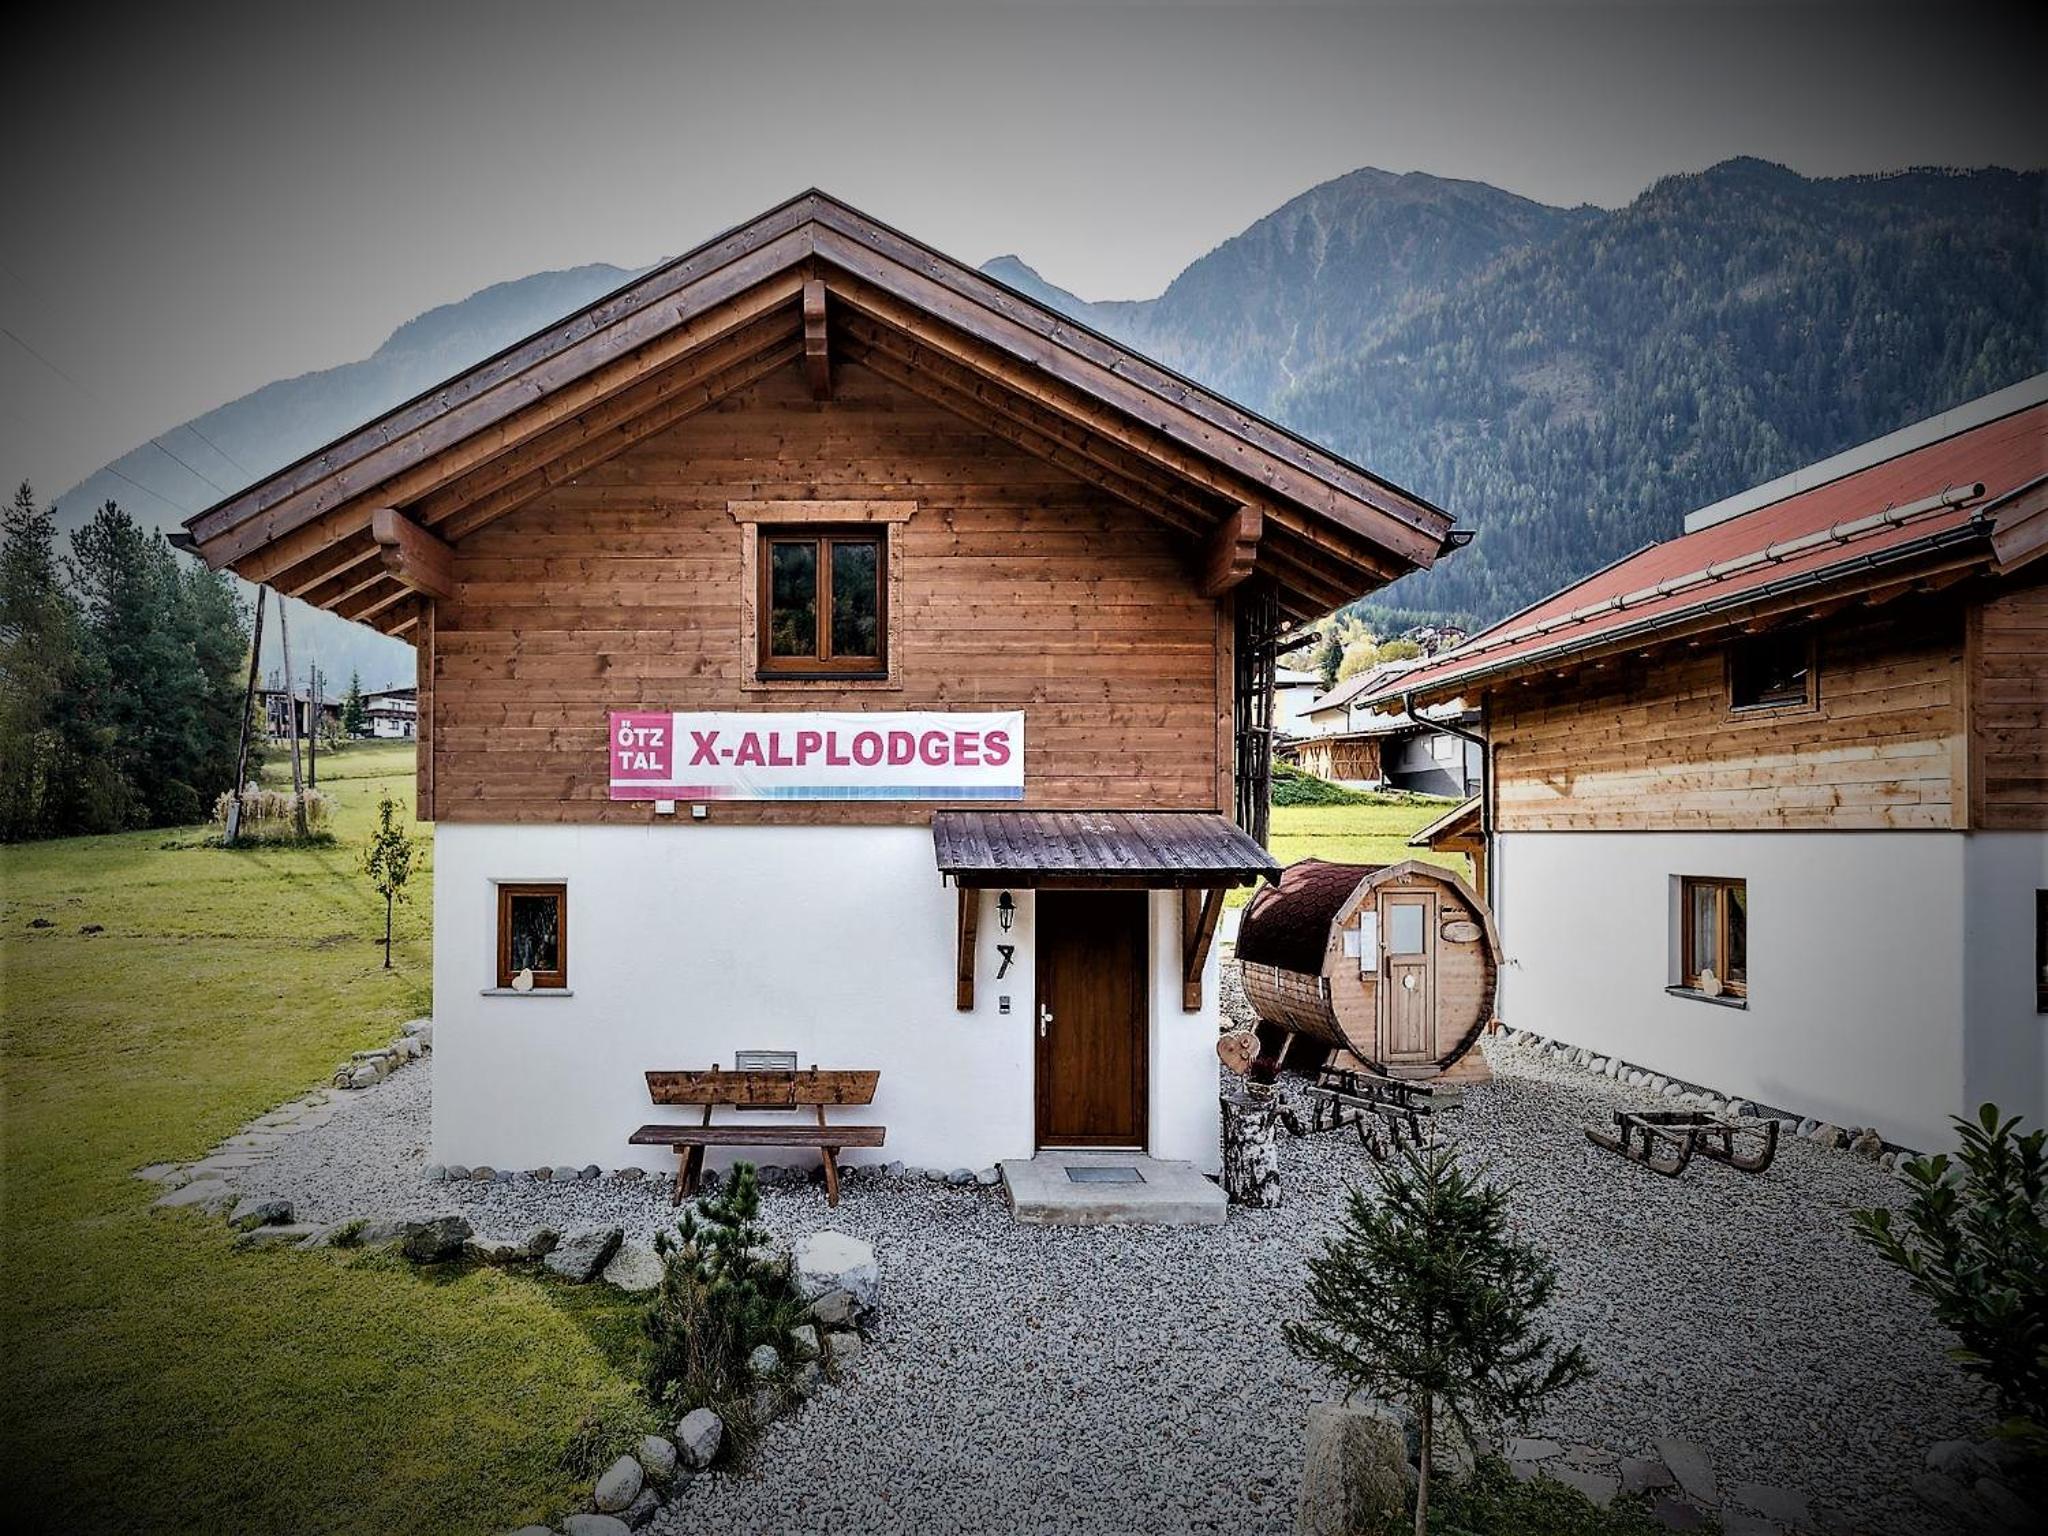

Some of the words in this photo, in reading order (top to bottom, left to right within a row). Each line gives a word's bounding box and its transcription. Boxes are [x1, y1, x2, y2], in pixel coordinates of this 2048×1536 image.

[617, 720, 664, 747] ÖTZ
[689, 731, 1011, 767] X-ALPLODGES
[618, 751, 663, 770] TAL
[996, 944, 1015, 980] 7
